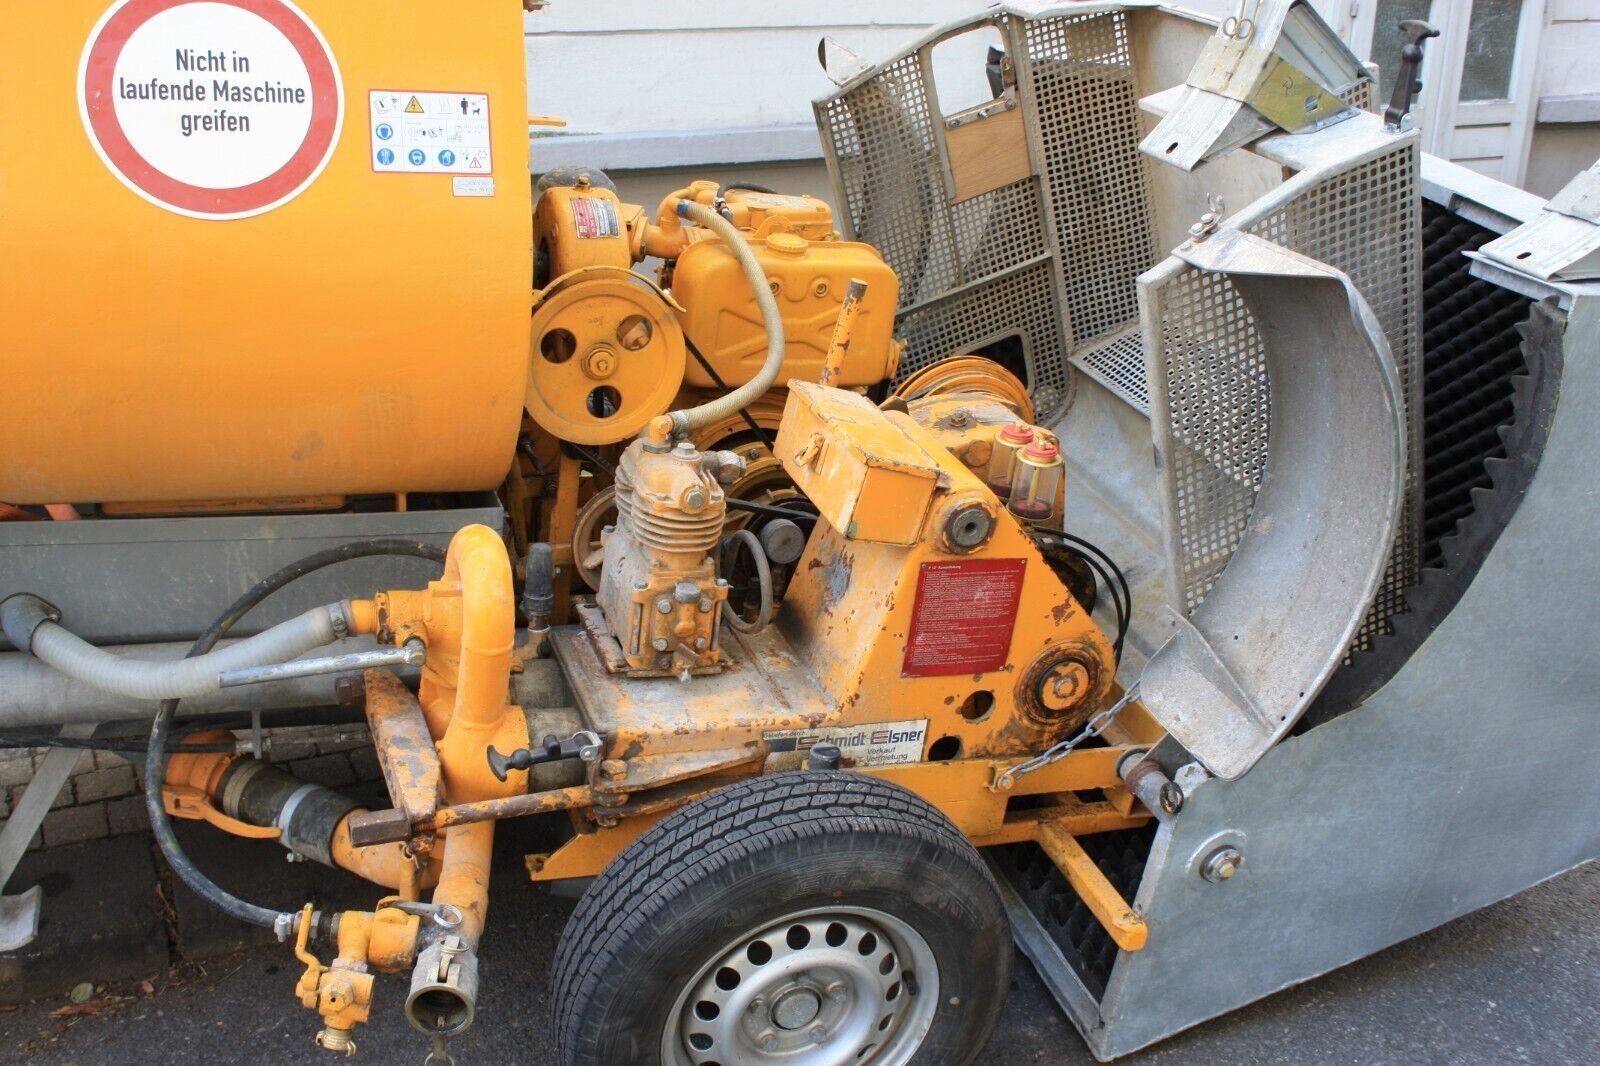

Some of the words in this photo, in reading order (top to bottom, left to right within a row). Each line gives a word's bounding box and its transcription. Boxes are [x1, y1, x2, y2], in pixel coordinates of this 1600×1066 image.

[175, 48, 227, 72] Nicht
[232, 50, 250, 73] in
[119, 77, 206, 101] laufende
[213, 79, 306, 104] Maschine
[180, 109, 251, 137] greifen
[871, 729, 924, 745] Elsner
[866, 752, 908, 763] Vermietung
[867, 745, 896, 755] Verkauf
